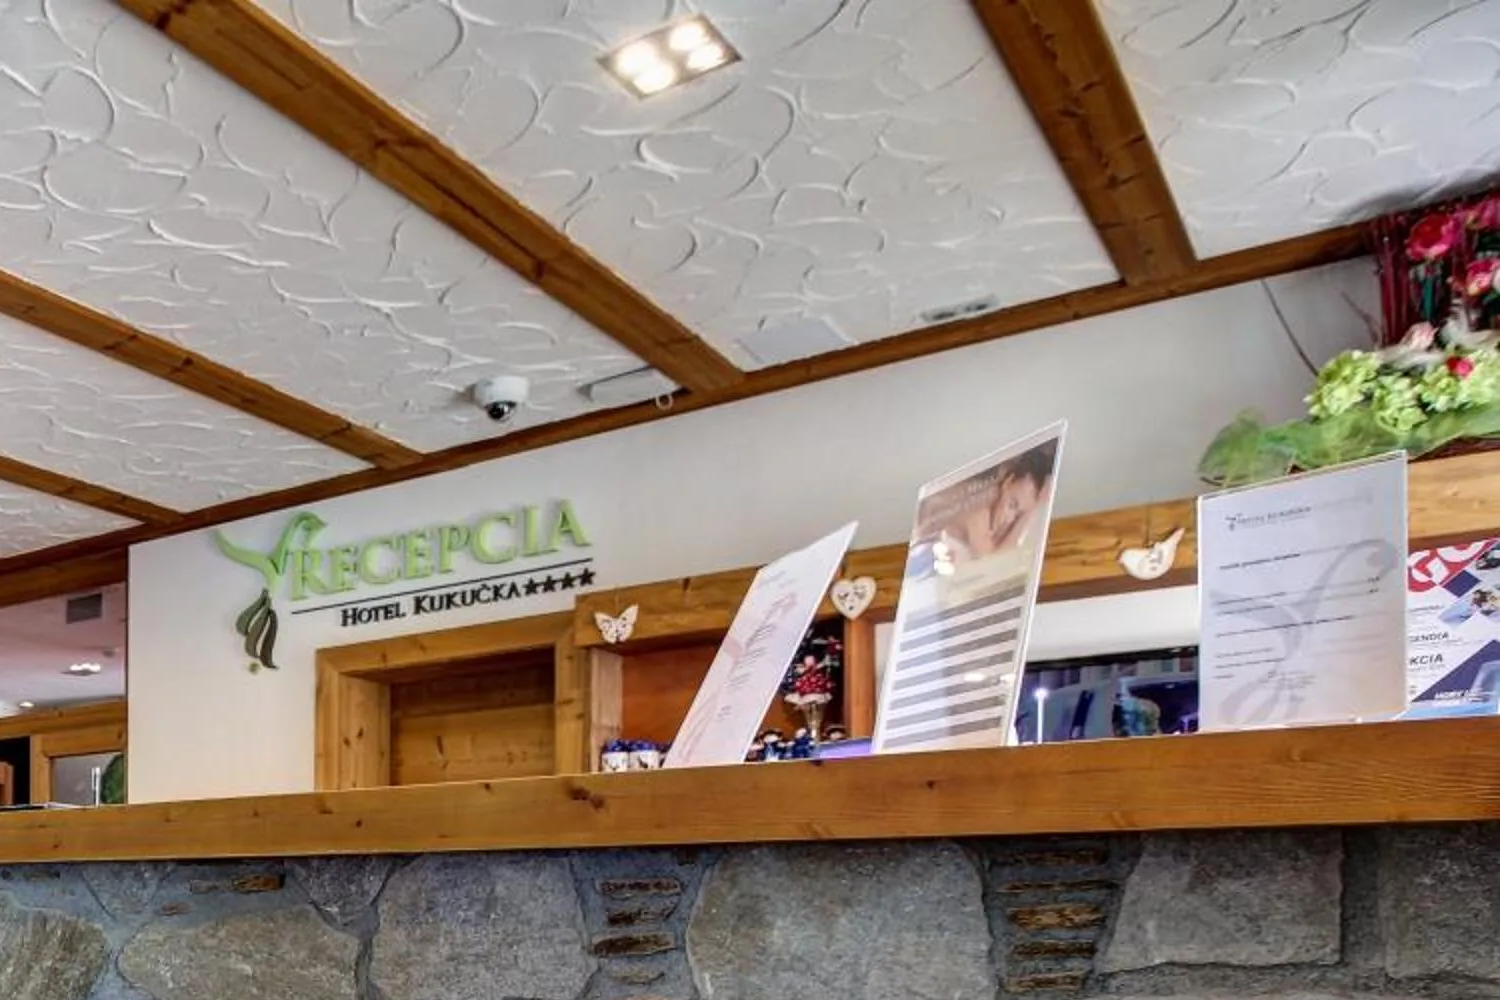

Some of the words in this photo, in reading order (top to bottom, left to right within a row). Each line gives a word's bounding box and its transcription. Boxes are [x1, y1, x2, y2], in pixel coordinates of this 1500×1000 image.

[287, 498, 593, 601] RECEPCIA
[341, 600, 407, 628] HOTEL
[414, 580, 525, 616] KUKUČKA
[1409, 652, 1444, 665] KCIA
